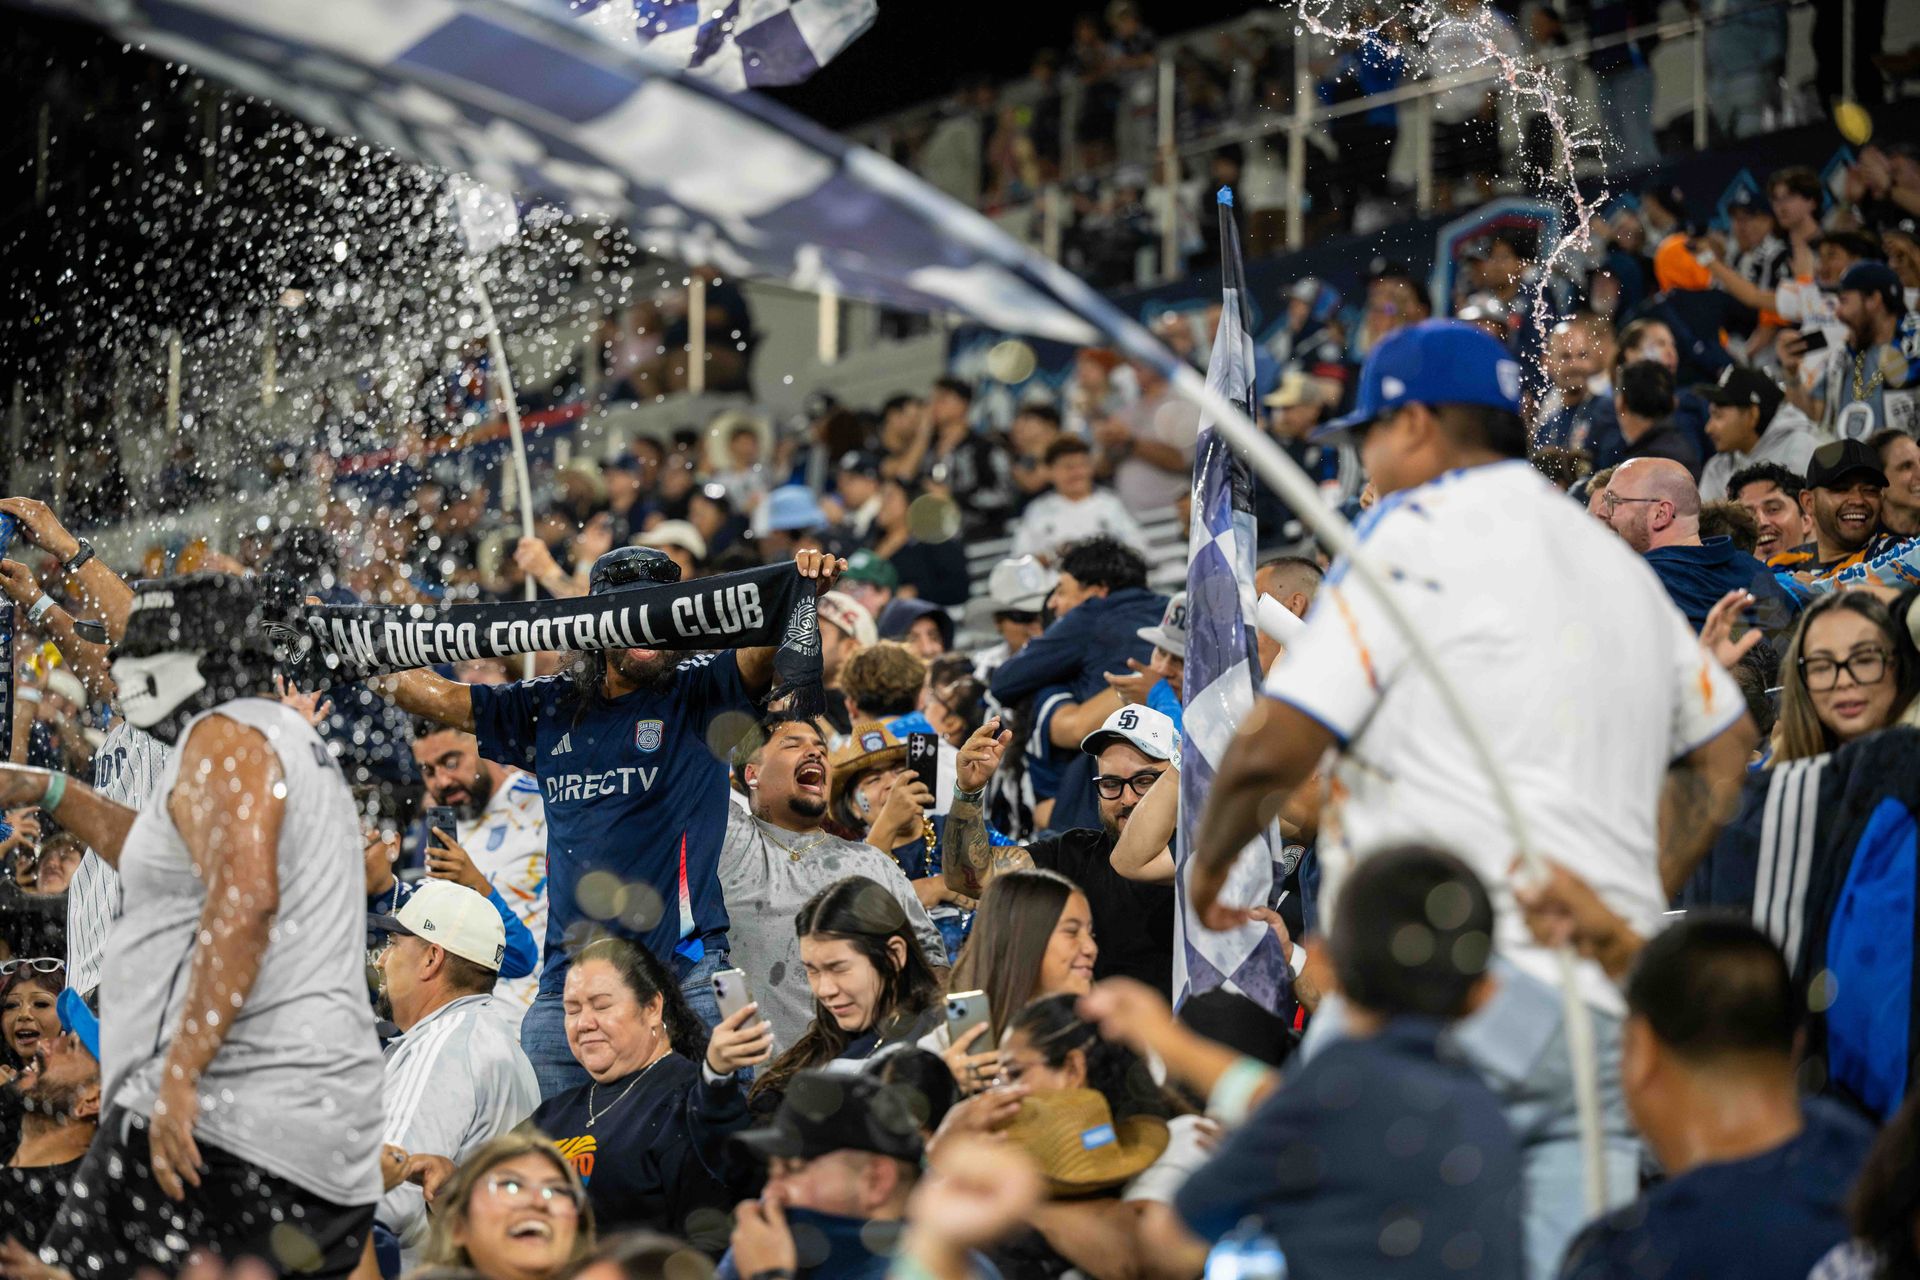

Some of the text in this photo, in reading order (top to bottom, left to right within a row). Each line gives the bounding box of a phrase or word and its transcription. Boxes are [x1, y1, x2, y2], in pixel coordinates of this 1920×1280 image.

[308, 615, 382, 667] SAN
[384, 621, 481, 667] DIEGO
[490, 604, 668, 657] FOOTBALL
[671, 582, 764, 637] CLUB
[1118, 710, 1139, 730] SD
[546, 766, 659, 804] DIRECTV
